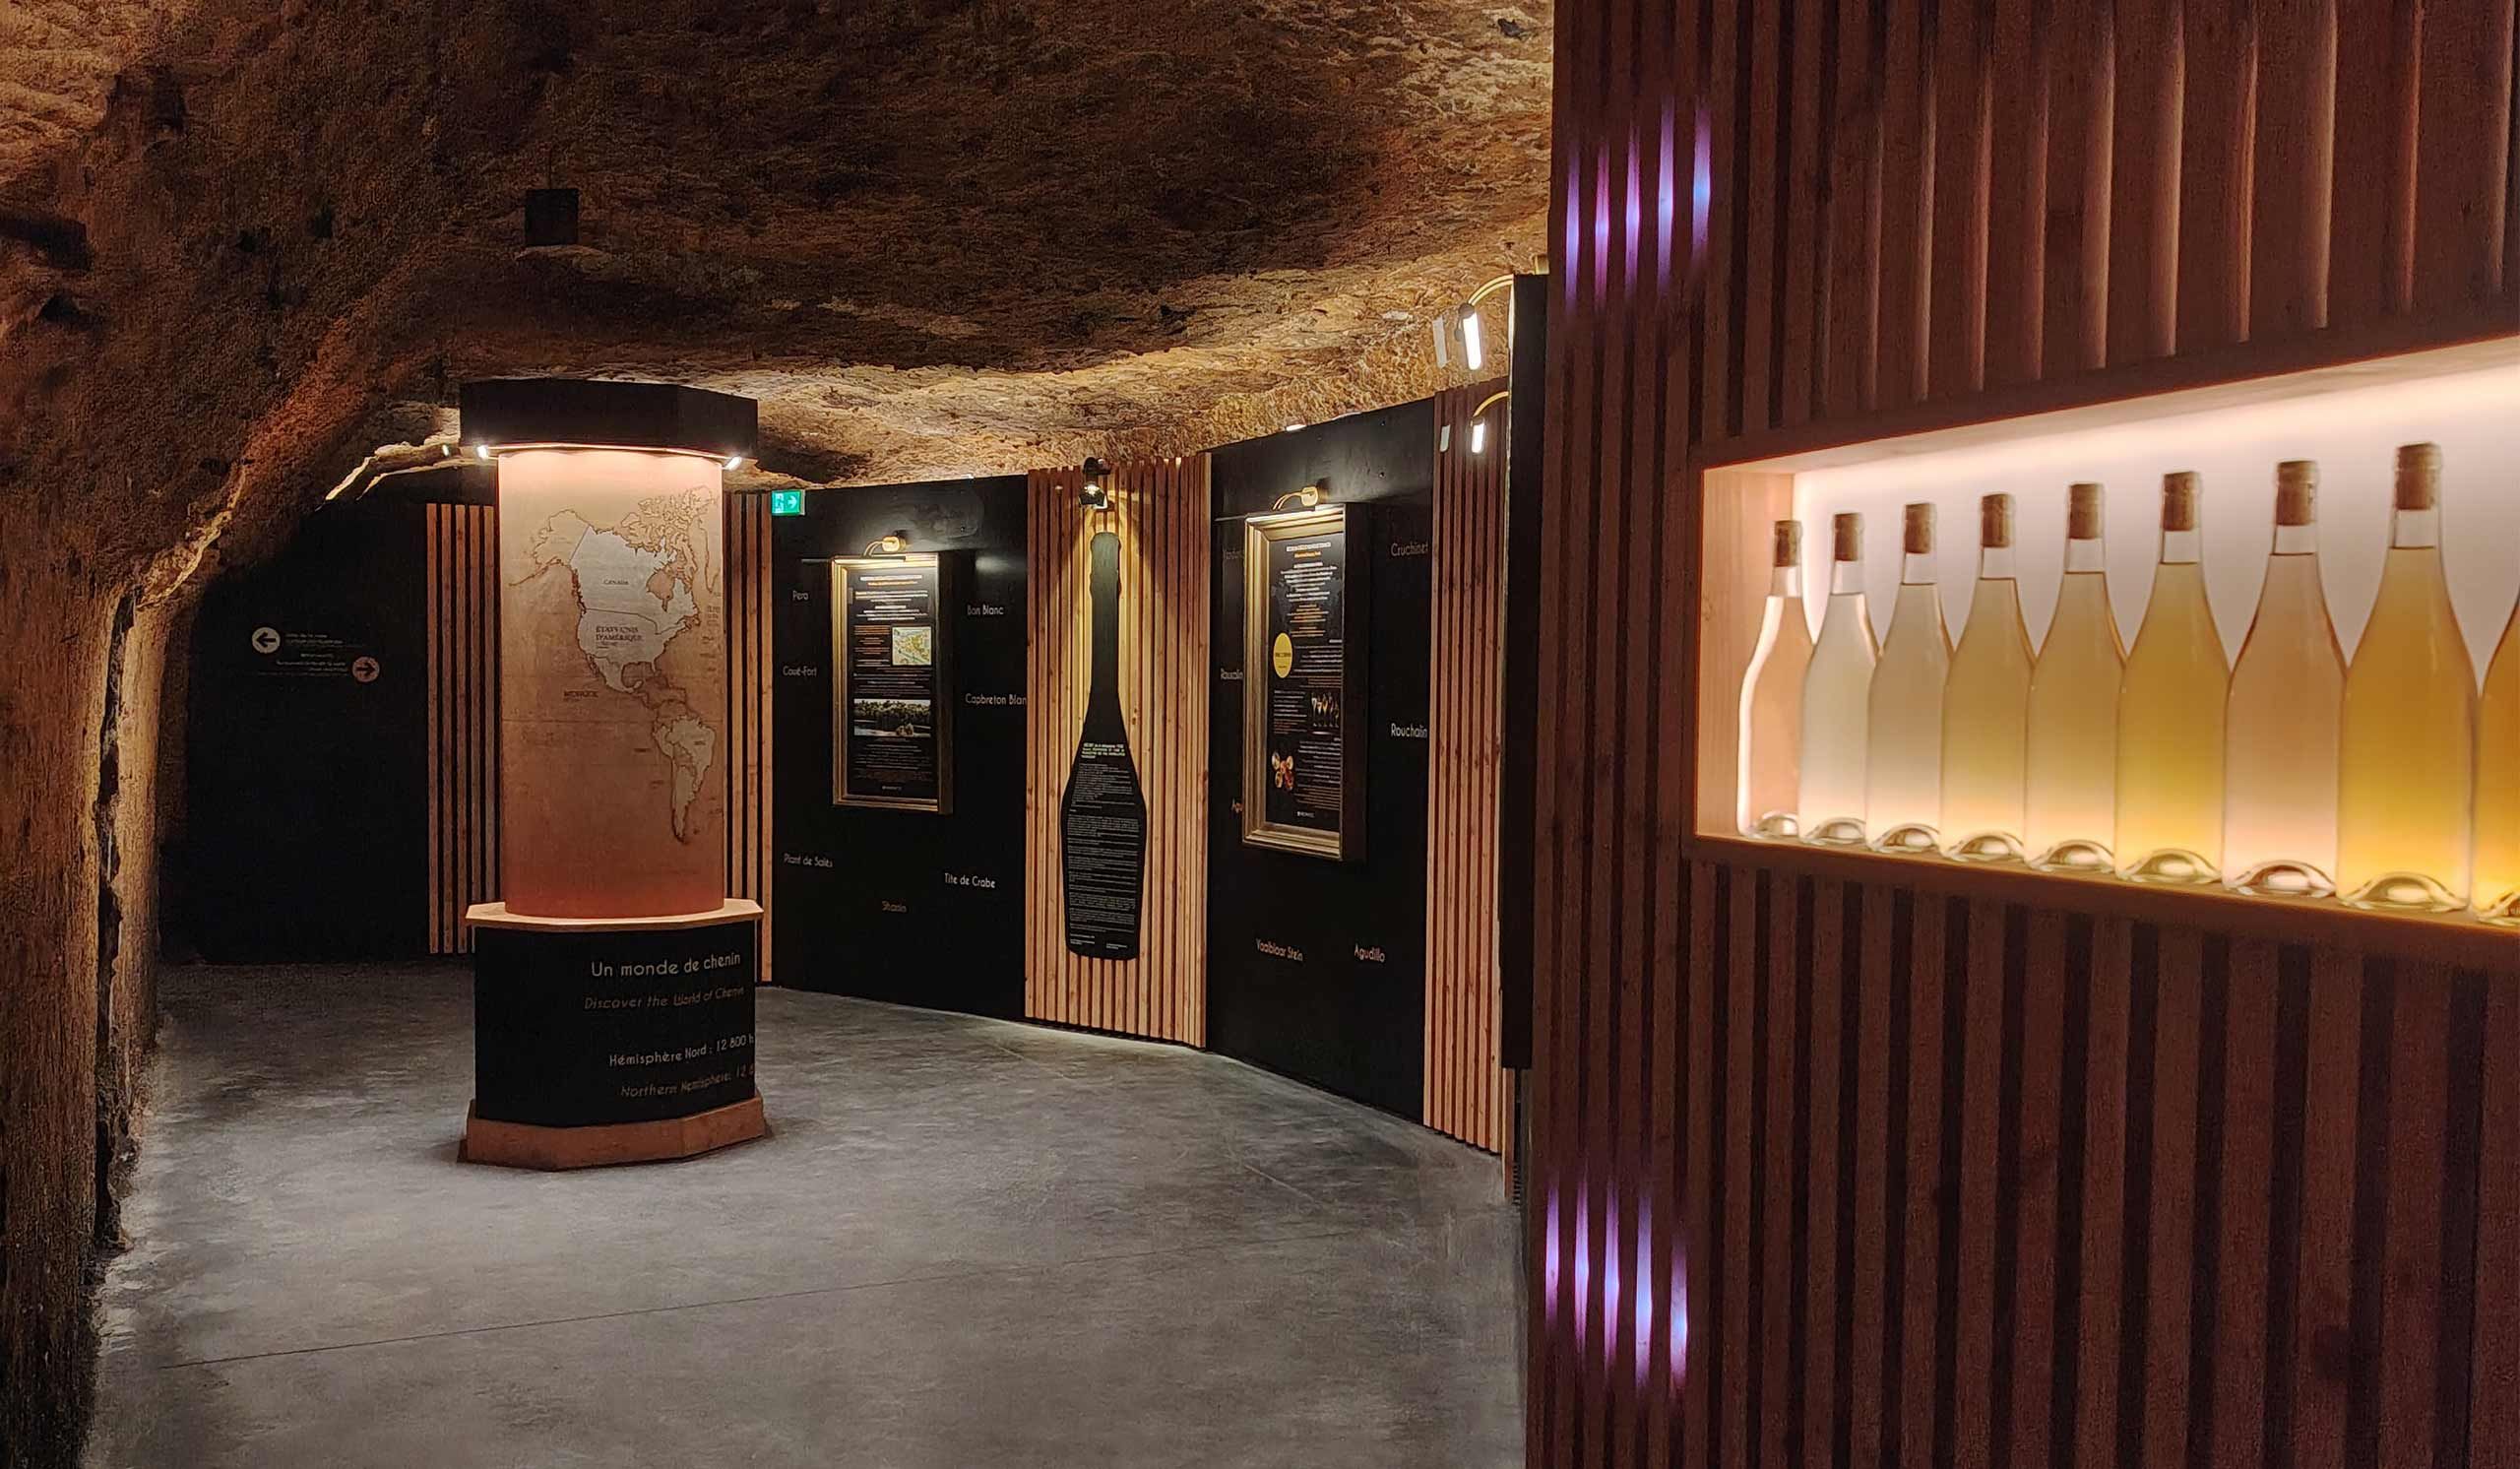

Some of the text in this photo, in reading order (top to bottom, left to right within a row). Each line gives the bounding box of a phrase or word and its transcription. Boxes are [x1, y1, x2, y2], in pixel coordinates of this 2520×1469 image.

[965, 692, 1007, 705] Capbreton
[960, 874, 971, 886] de
[972, 875, 996, 889] Crabe
[591, 951, 741, 977] Un monde de chenin
[584, 996, 642, 1010] Discover
[647, 994, 670, 1007] the
[684, 1043, 708, 1059] Nord
[621, 1080, 677, 1098] Northern
